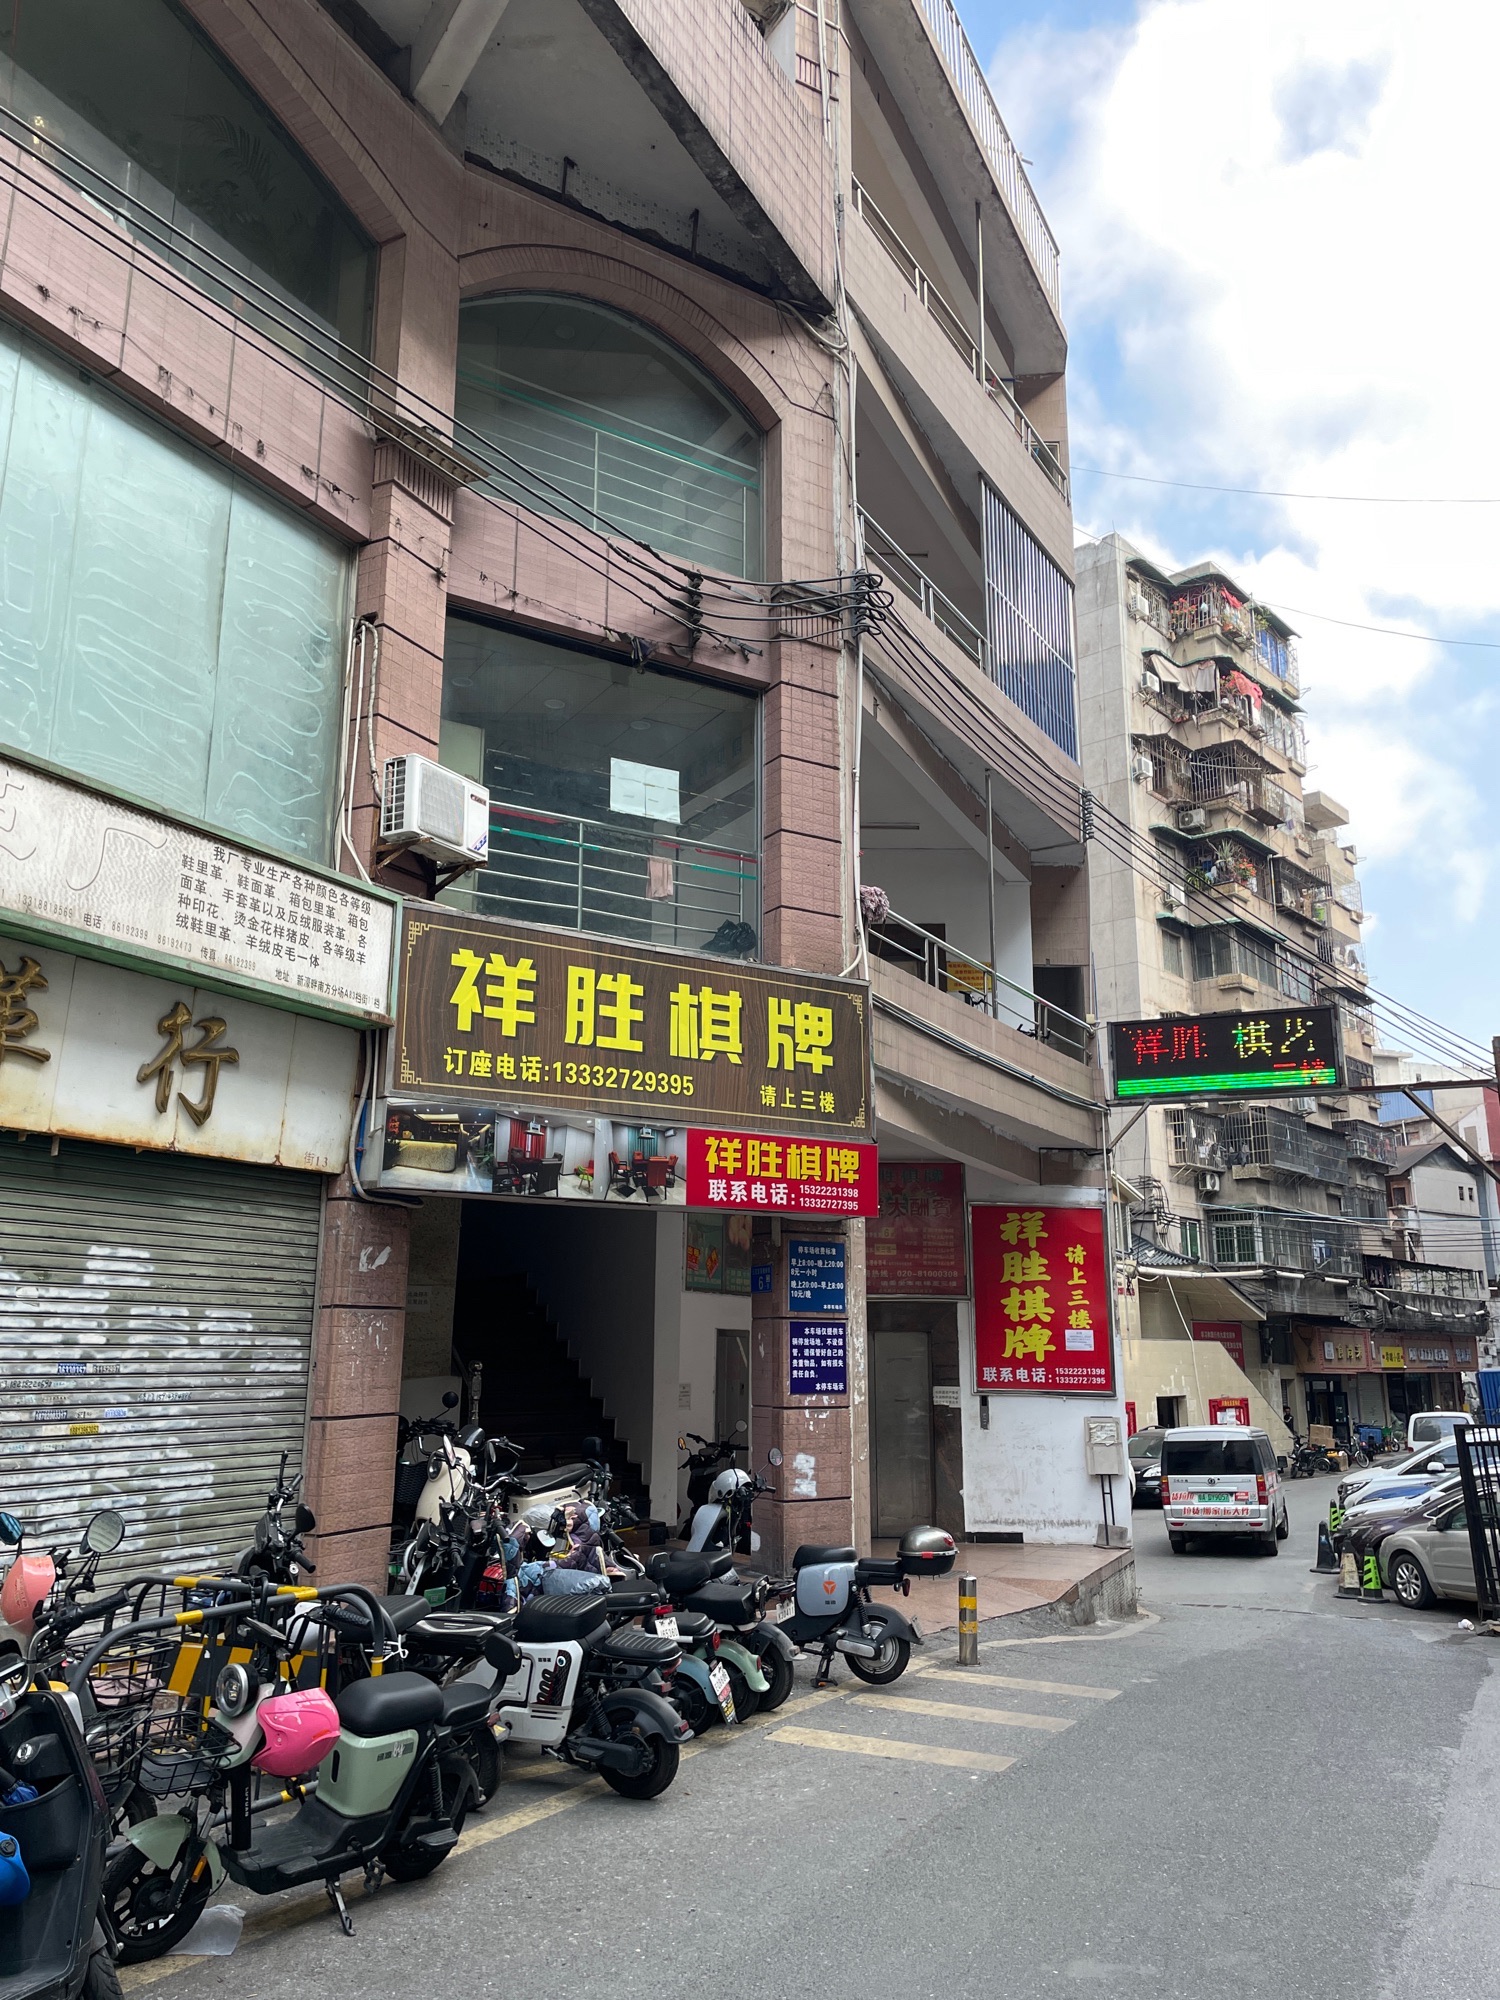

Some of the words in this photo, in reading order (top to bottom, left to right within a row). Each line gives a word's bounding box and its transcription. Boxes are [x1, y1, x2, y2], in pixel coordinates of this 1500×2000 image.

[213, 846, 372, 916] 我厂专业生产各种颜色各等级
[450, 948, 836, 1075] 祥胜棋牌
[443, 1047, 695, 1097] 订座电话:13332729395
[759, 1085, 836, 1115] 请上三楼
[704, 1136, 861, 1185] 祥胜棋牌
[708, 1179, 797, 1207] 联系电话:
[799, 1185, 860, 1199] 15322231398
[799, 1198, 860, 1212] 13332727395
[896, 1269, 959, 1279] 020-81000308
[999, 1210, 1056, 1364] 祥胜棋牌
[1064, 1244, 1093, 1330] 请上三楼
[982, 1366, 1053, 1384] 联系电话:
[1054, 1366, 1106, 1377] 15322231398
